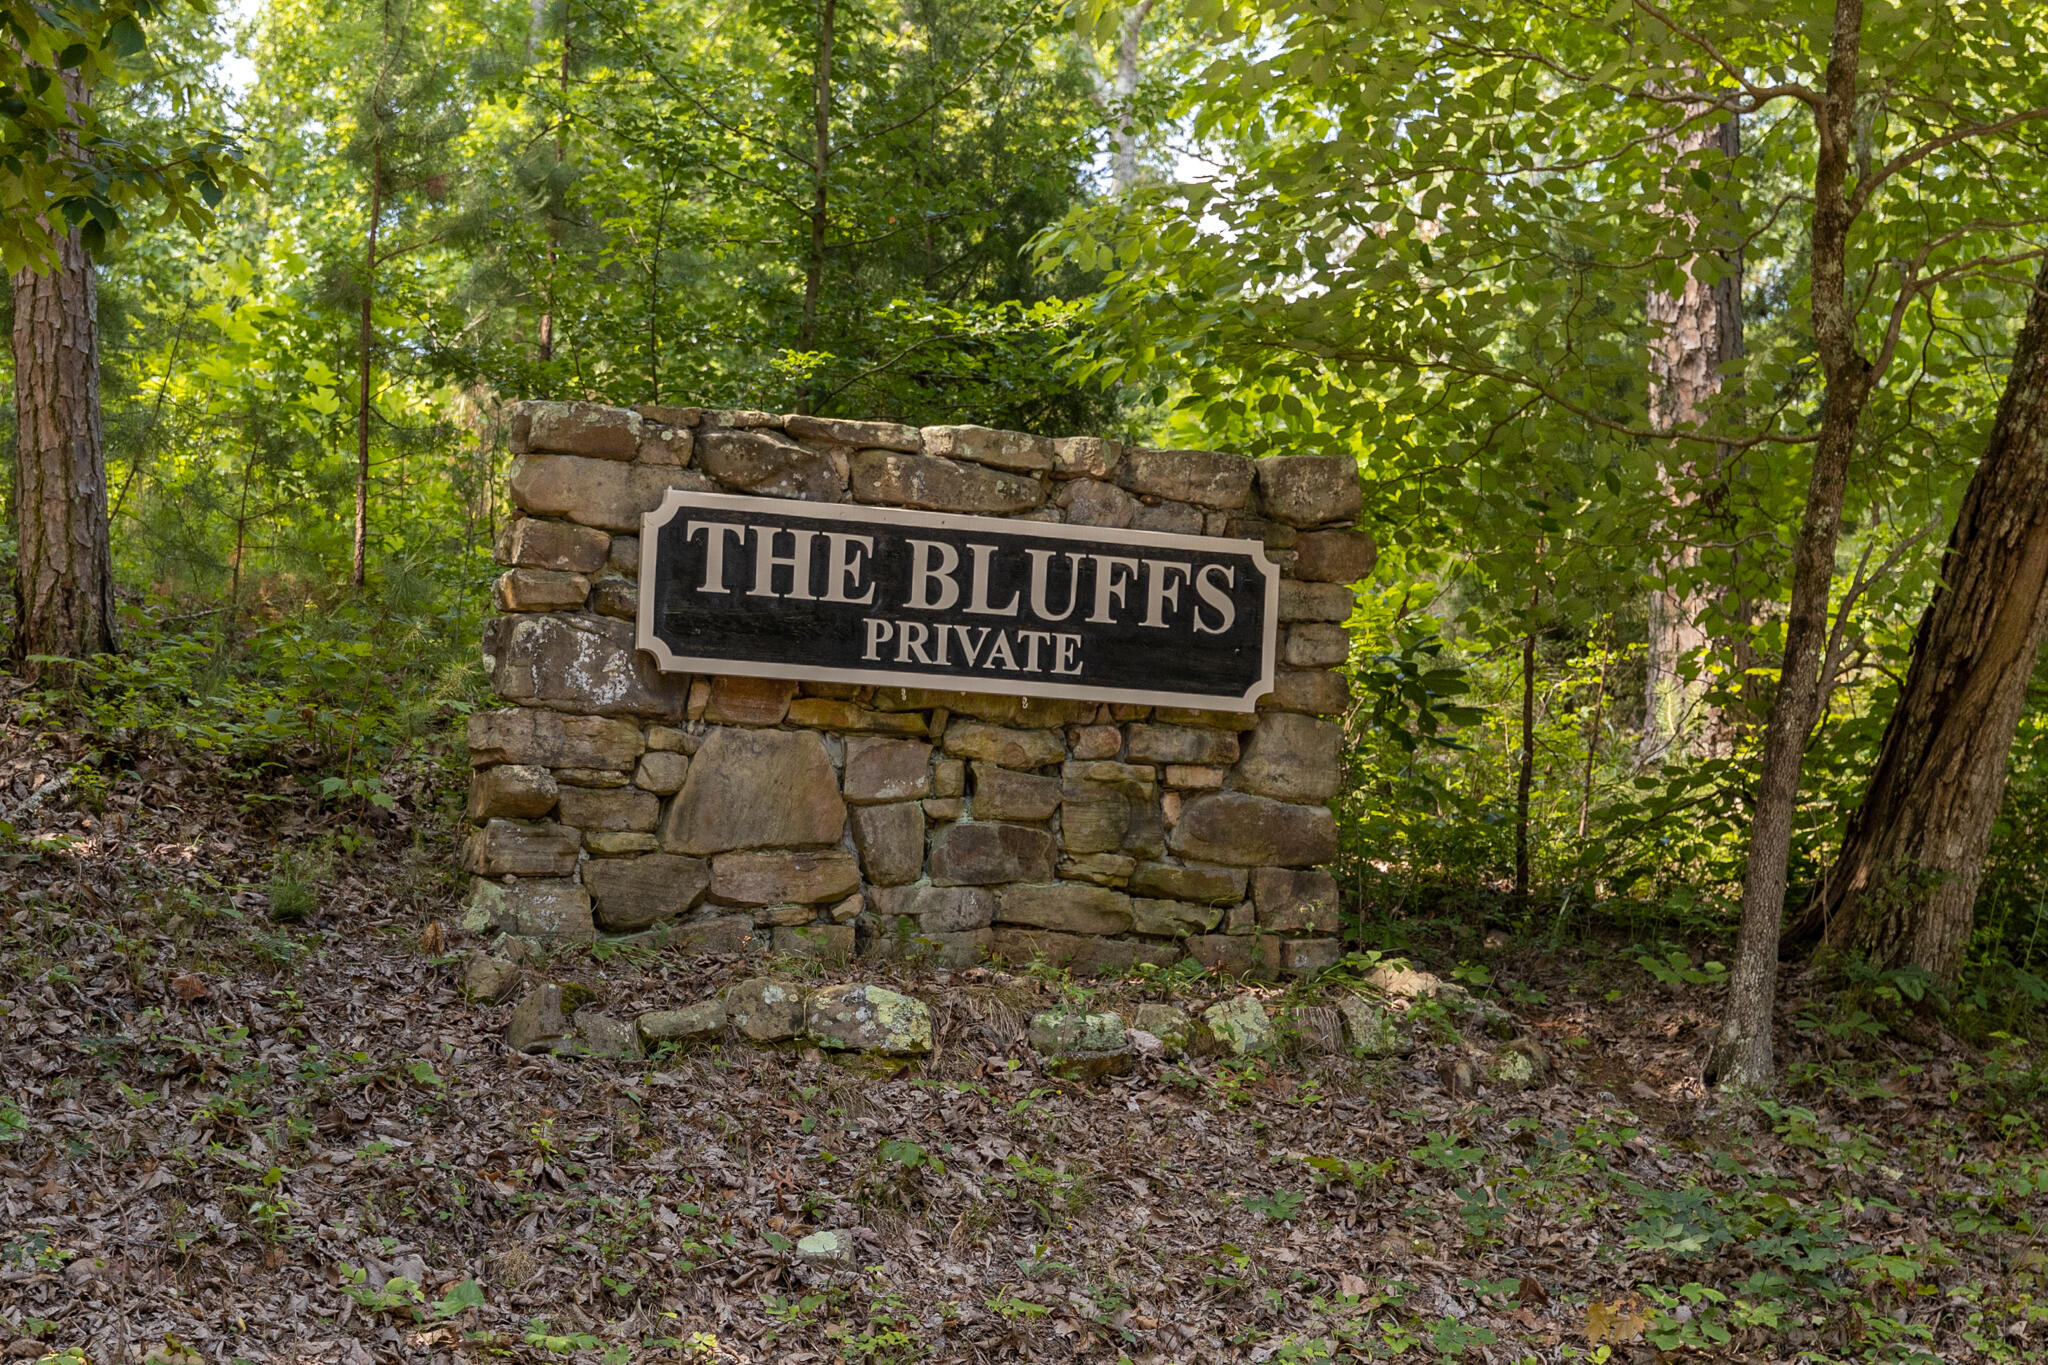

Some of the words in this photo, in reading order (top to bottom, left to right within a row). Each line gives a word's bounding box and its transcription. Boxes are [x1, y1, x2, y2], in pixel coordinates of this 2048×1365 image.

[686, 520, 876, 606] THE
[902, 539, 1236, 635] BLUFFS
[861, 617, 1084, 676] PRIVATE
